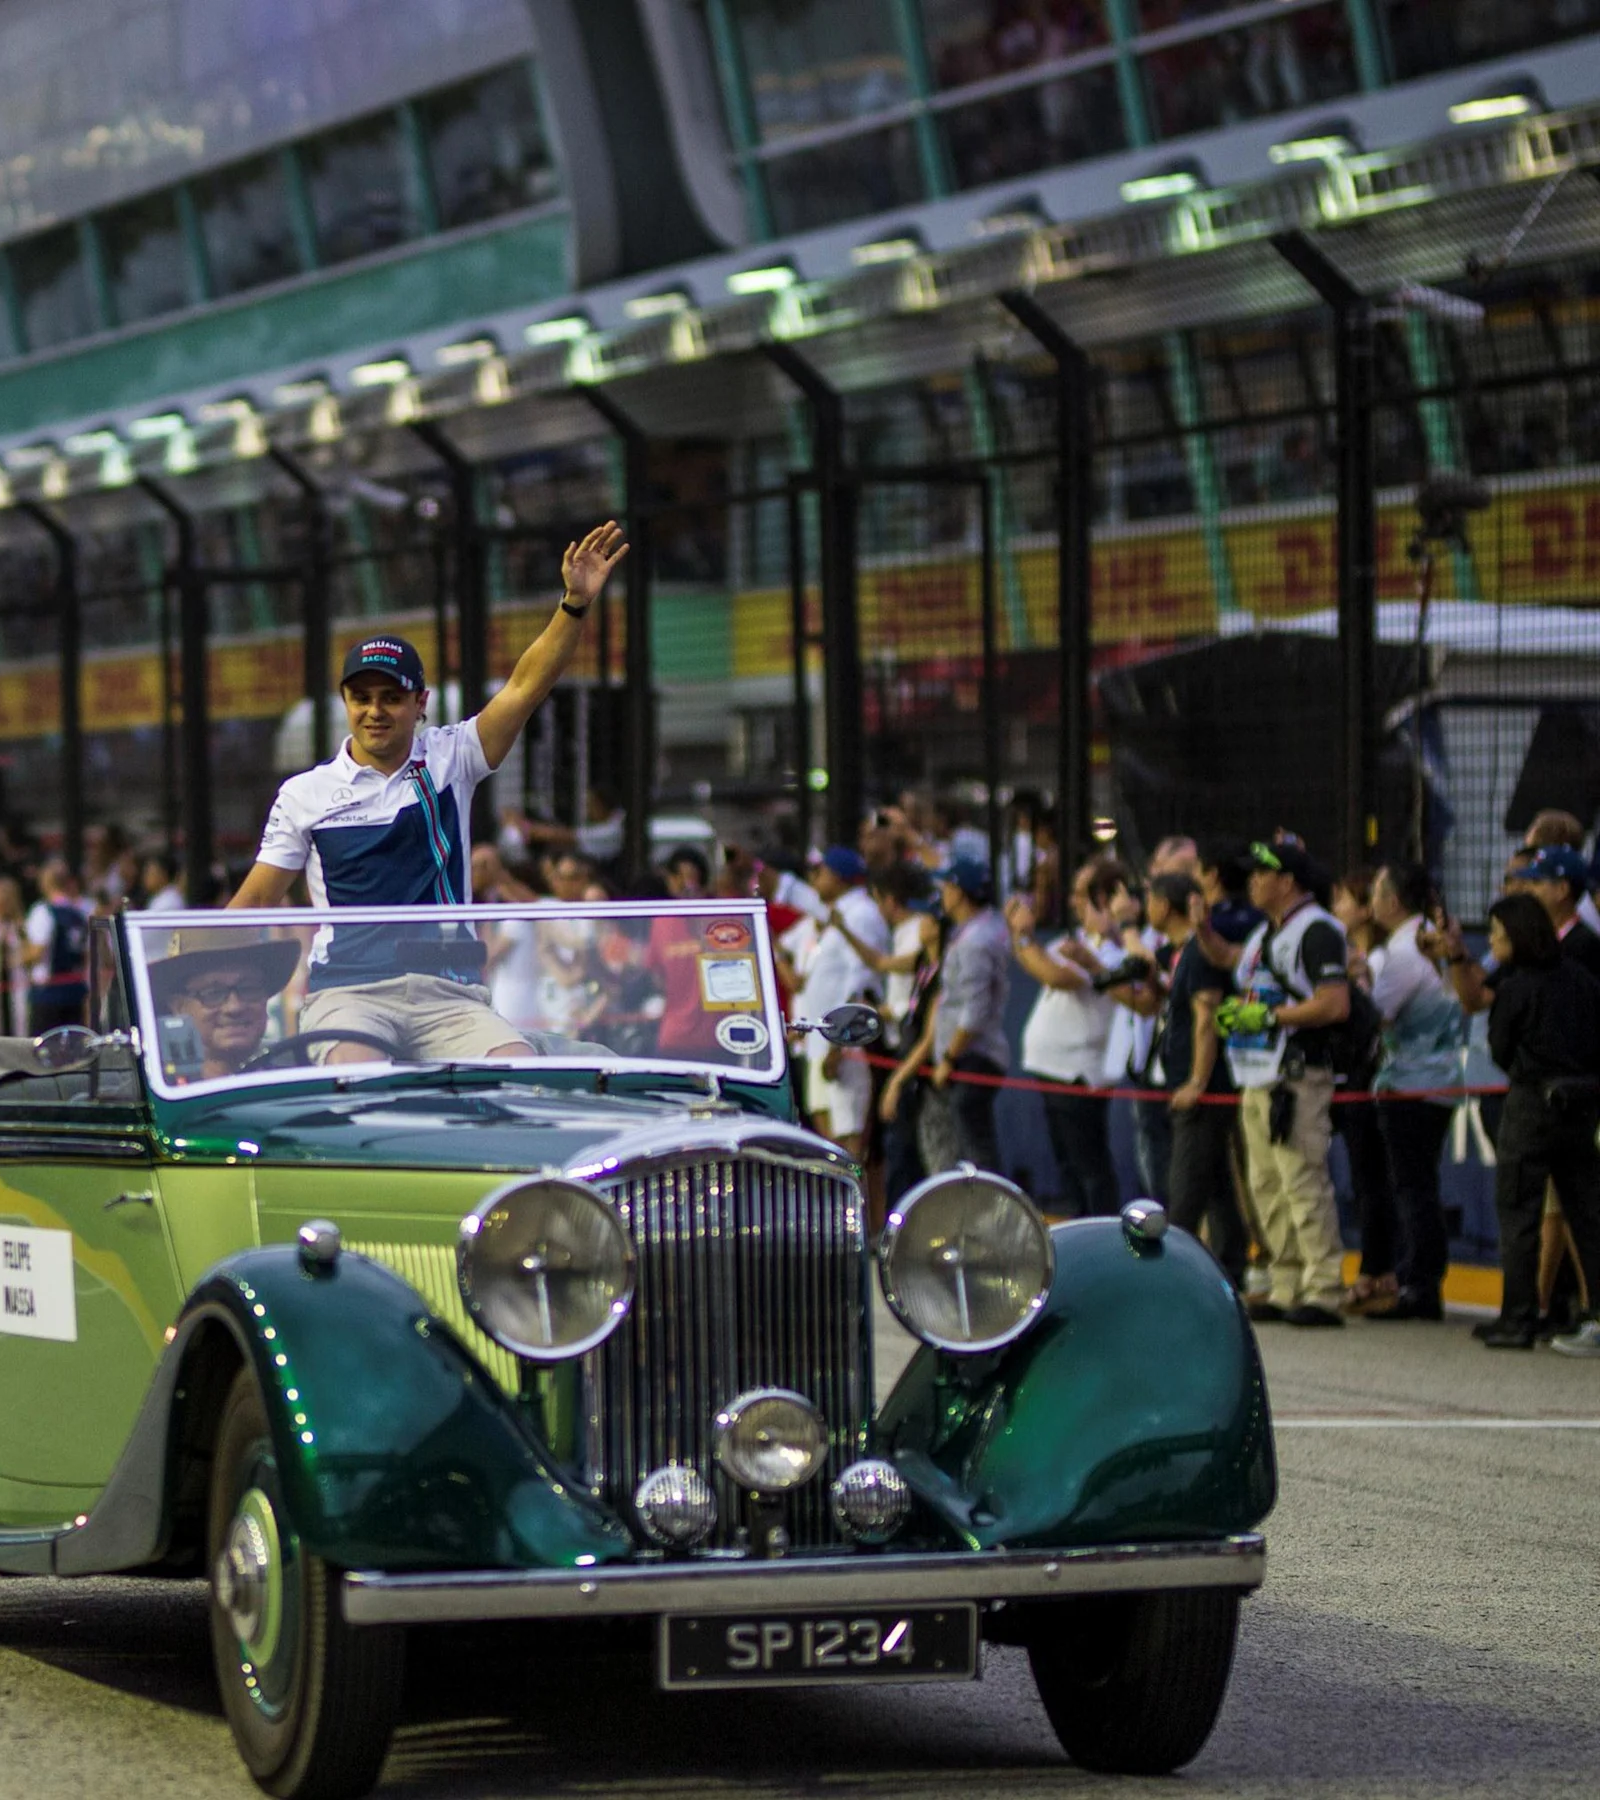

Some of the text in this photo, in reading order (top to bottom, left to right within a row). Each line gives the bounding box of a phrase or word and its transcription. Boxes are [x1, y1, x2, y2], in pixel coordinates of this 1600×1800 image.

[362, 640, 403, 653] WILLIAMS
[362, 655, 398, 665] RACING
[3, 1240, 31, 1271] FELIPE
[726, 1618, 916, 1670] SP1234
